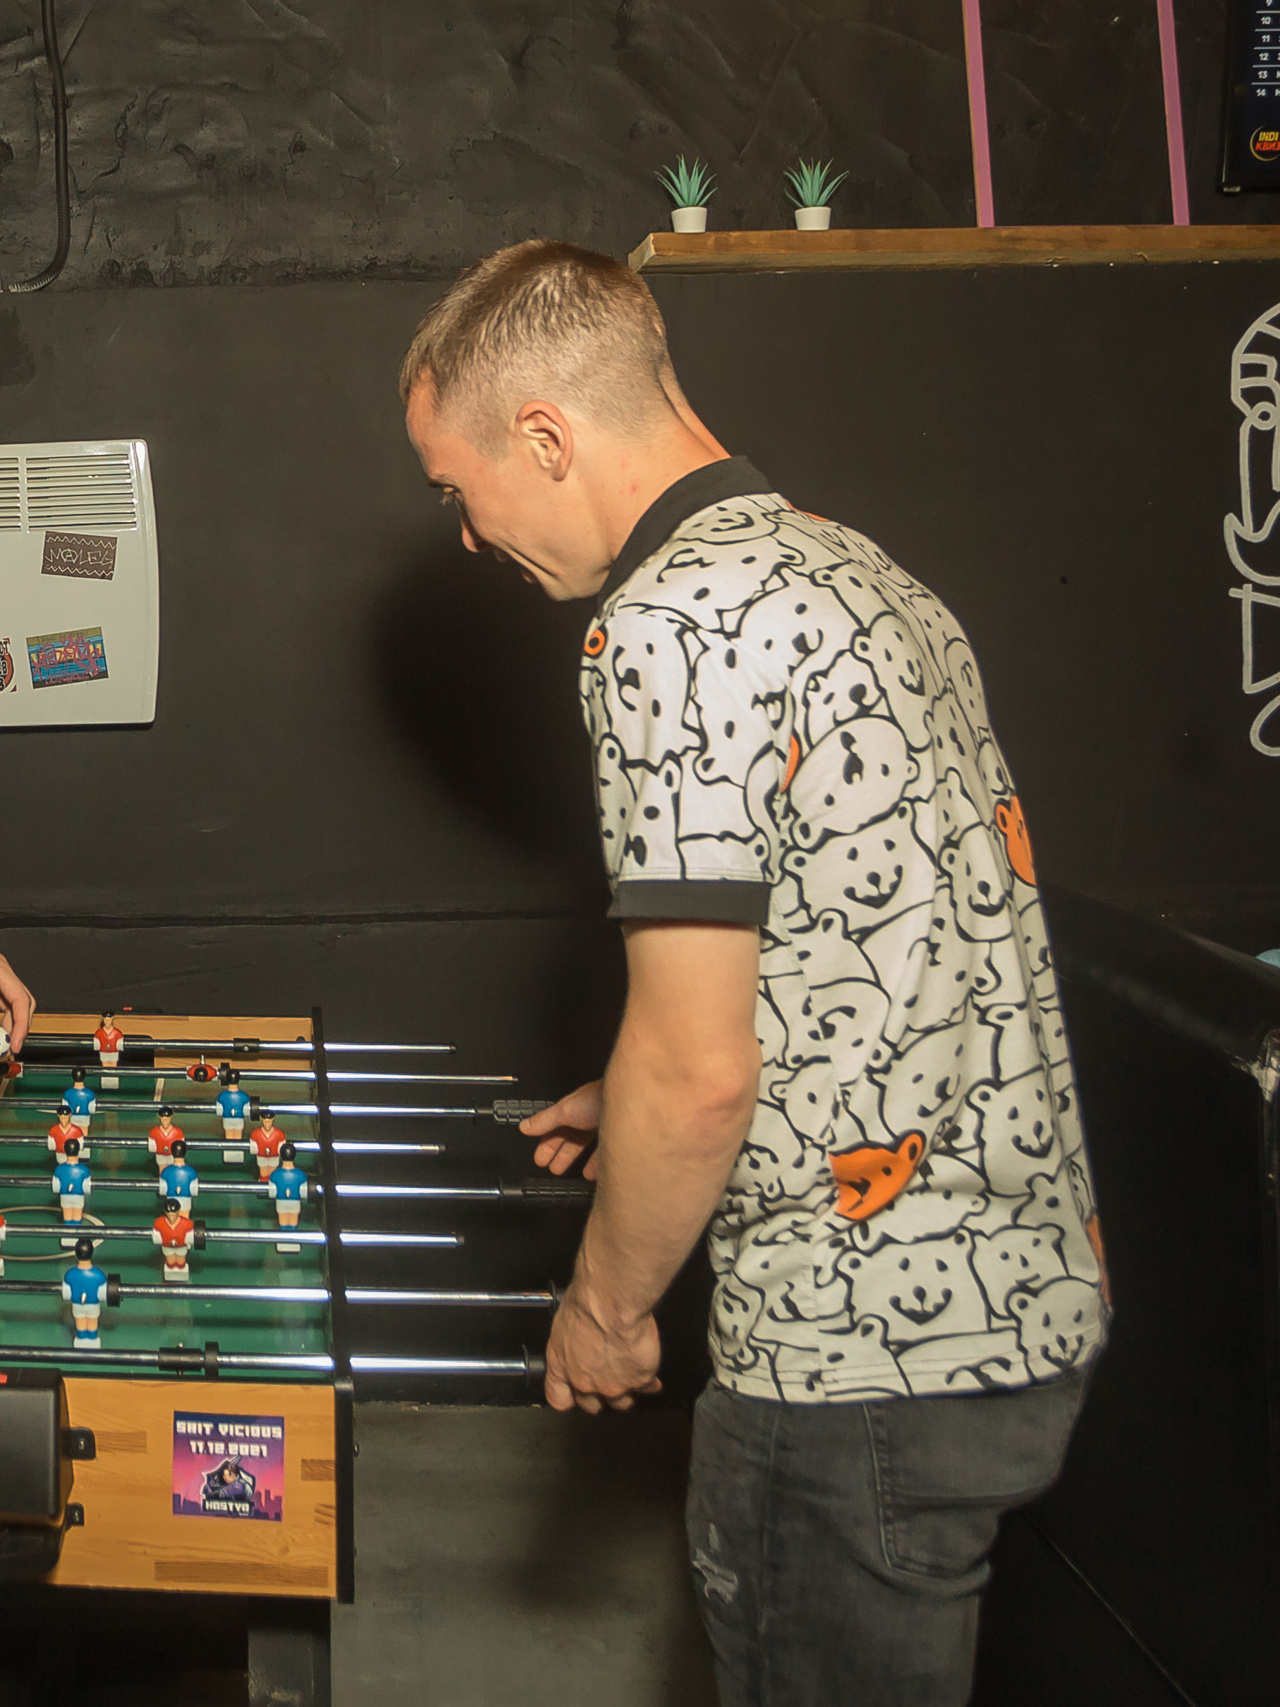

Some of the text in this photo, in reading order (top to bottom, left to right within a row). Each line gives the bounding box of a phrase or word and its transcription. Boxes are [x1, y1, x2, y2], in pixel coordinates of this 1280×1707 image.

[1261, 16, 1271, 25] 10
[1261, 34, 1271, 43] 11
[1259, 52, 1269, 61] 12
[1257, 70, 1268, 79] 13
[1256, 88, 1266, 97] 14
[1258, 131, 1279, 142] INDI
[176, 1420, 282, 1439] SHIT VICIOUS
[190, 1440, 267, 1457] 11.12.2021
